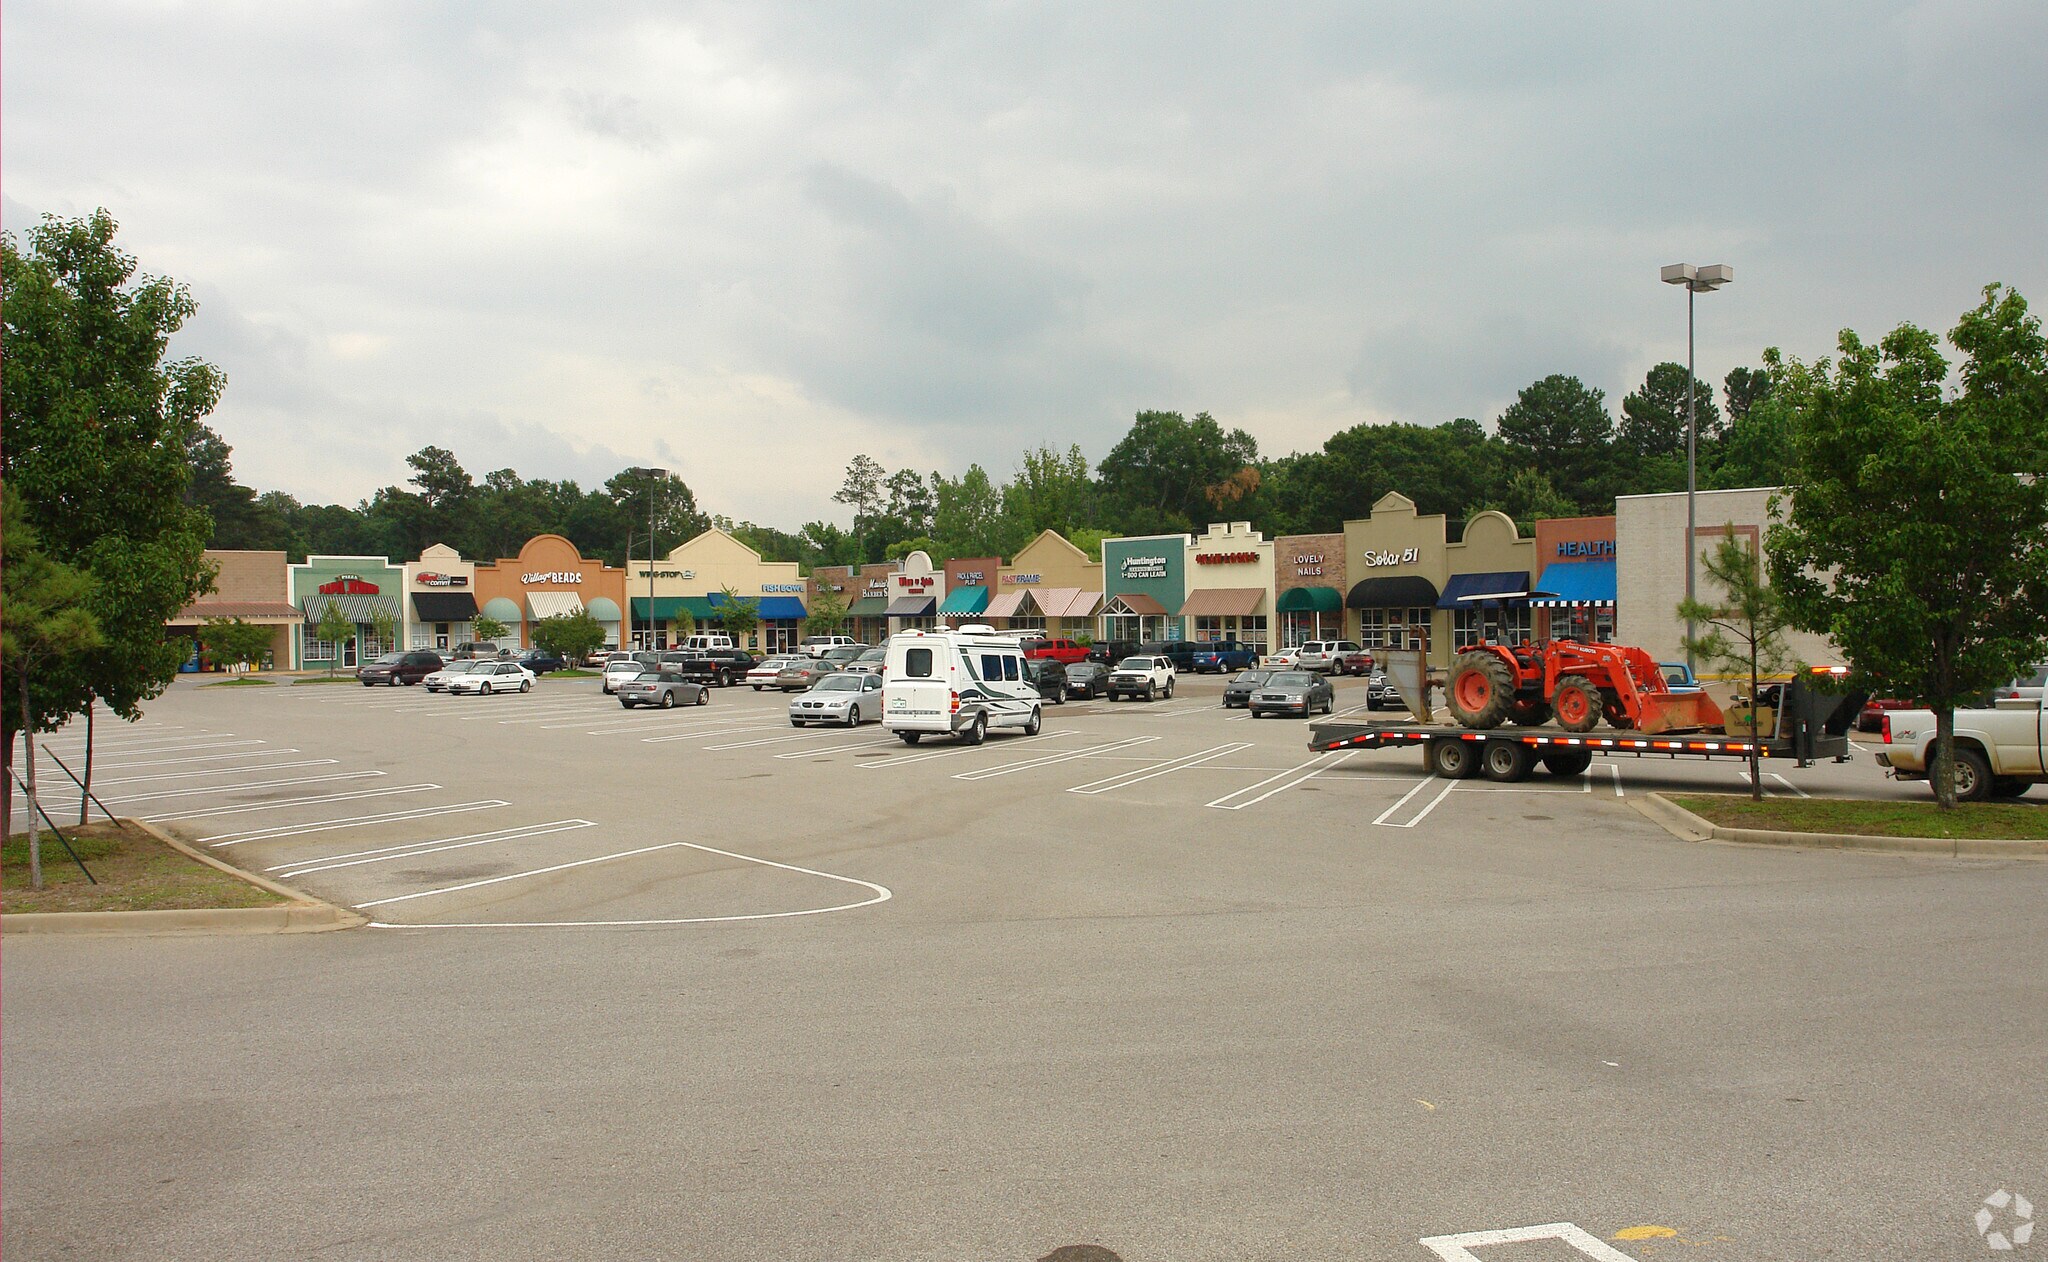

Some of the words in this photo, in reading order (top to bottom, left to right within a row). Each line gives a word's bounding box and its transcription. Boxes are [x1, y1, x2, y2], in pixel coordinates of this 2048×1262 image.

[1126, 556, 1166, 567] Huntington
[1293, 554, 1324, 564] LOVELY
[1364, 550, 1400, 567] Solar
[1402, 548, 1420, 562] 51
[1297, 567, 1322, 576] NAILS
[551, 572, 582, 584] BEADS
[761, 584, 779, 593] FISH
[779, 584, 805, 593] BOWL
